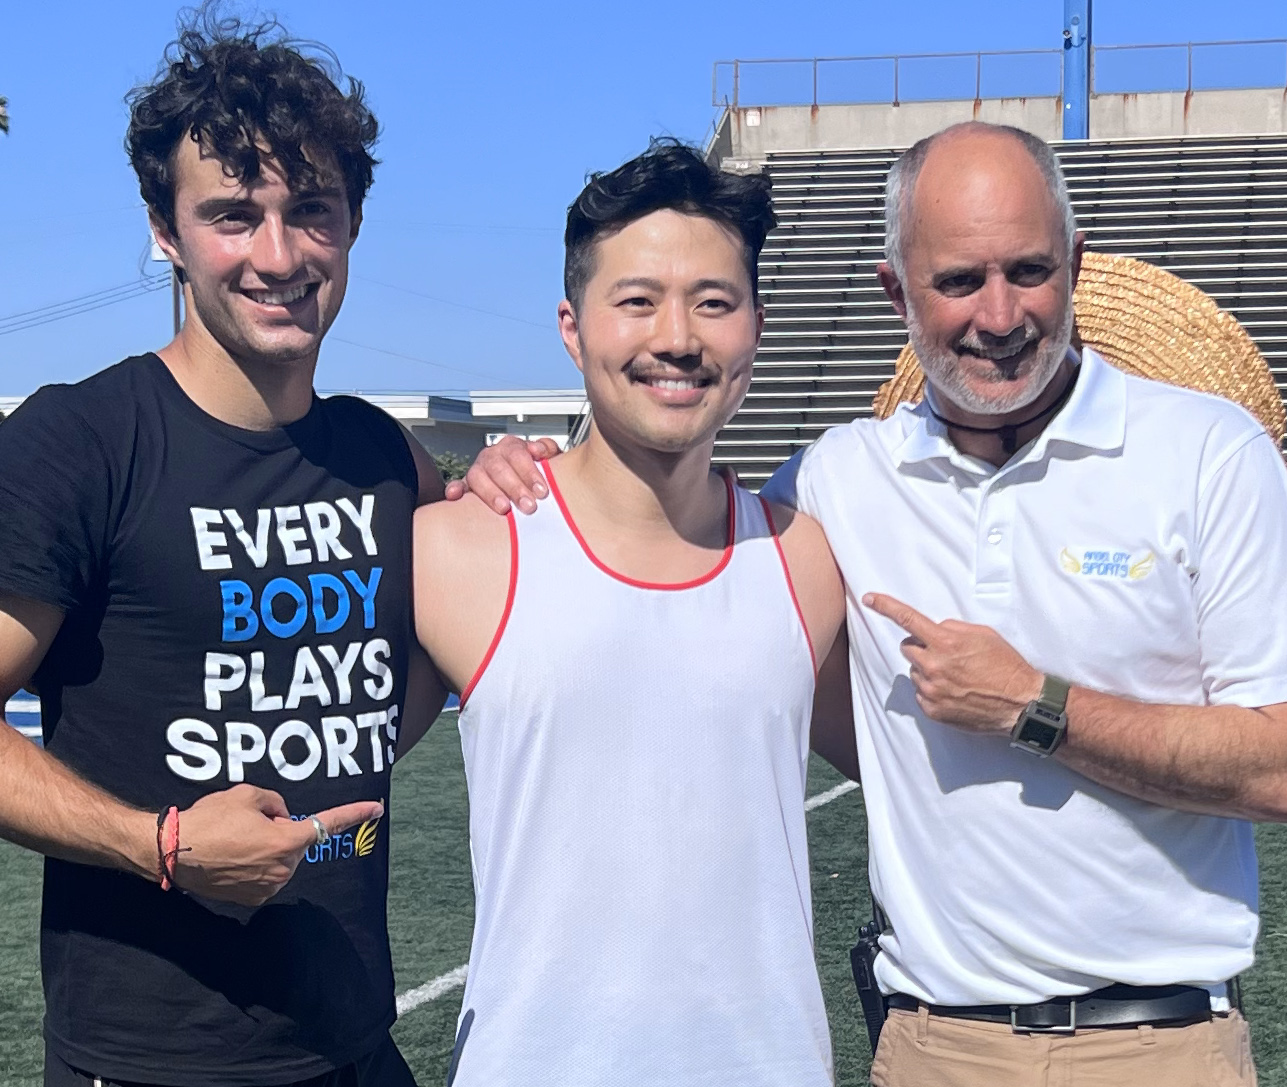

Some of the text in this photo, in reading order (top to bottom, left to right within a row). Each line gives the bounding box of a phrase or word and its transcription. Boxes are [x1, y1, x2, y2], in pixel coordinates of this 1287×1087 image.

[190, 495, 378, 570] EVERY
[1082, 562, 1128, 578] SPORTS
[220, 567, 383, 642] BODY
[203, 638, 393, 712] PLAYS
[165, 704, 399, 783] SPORTS
